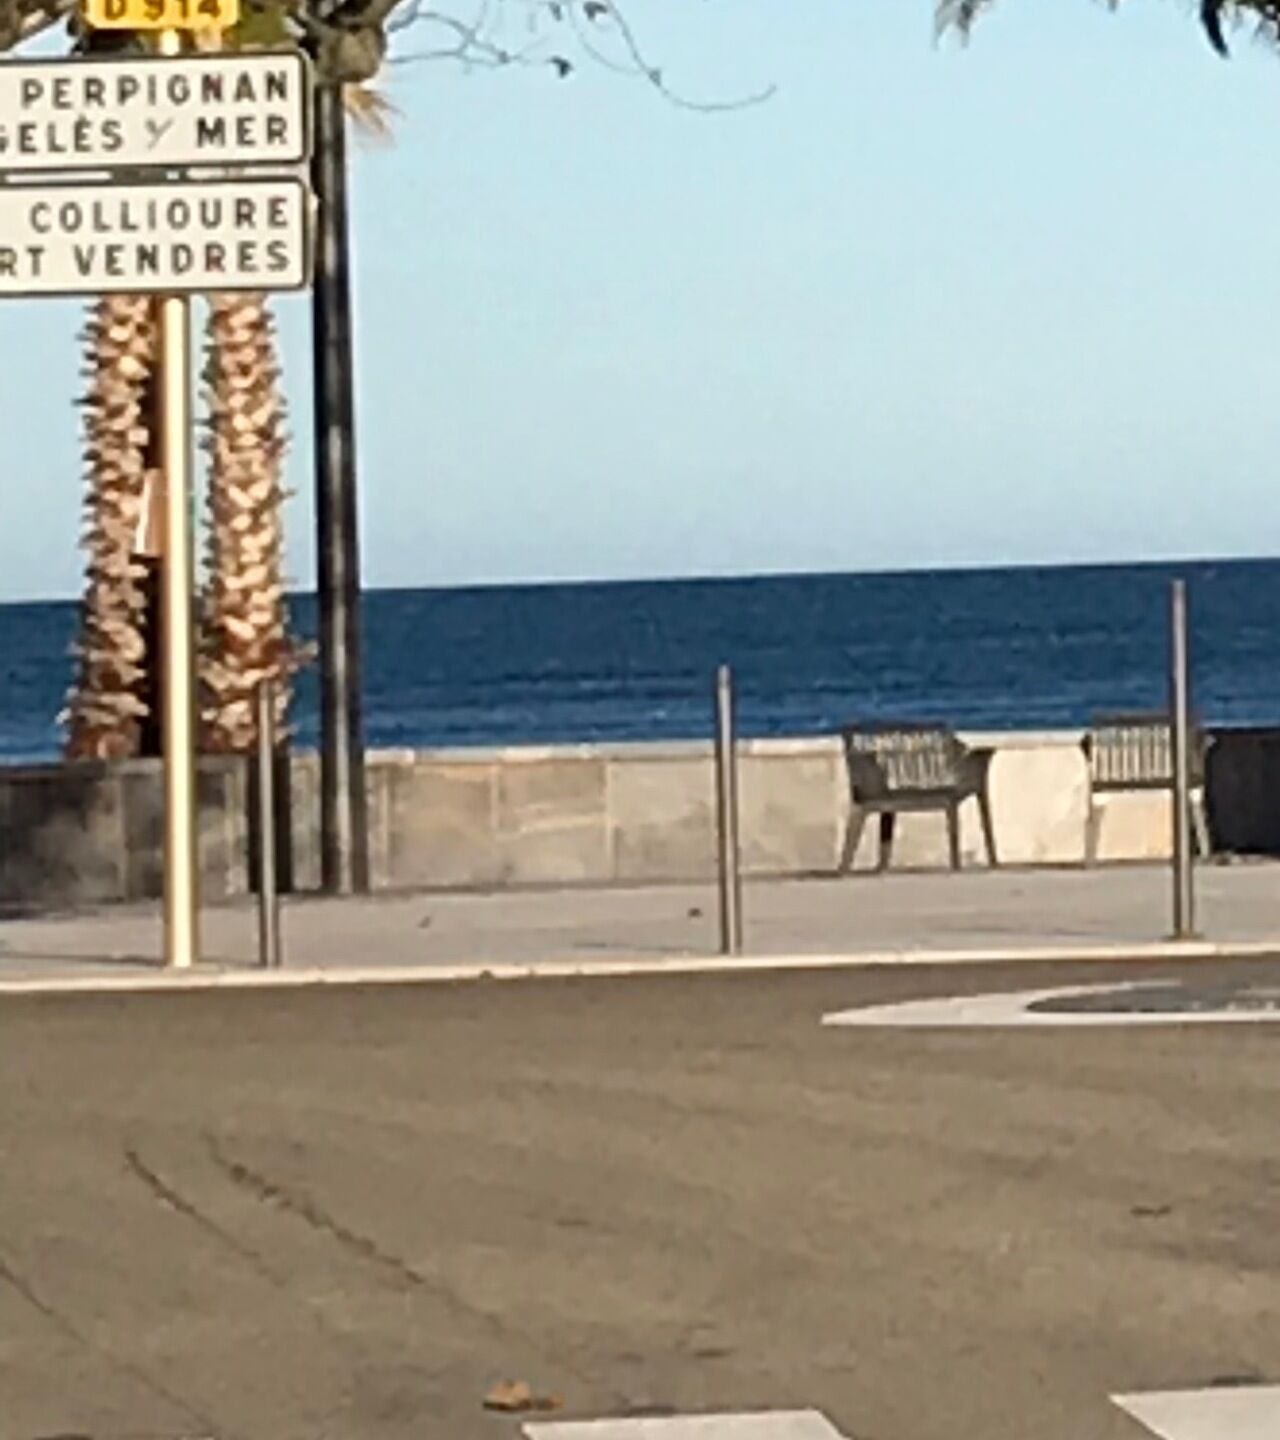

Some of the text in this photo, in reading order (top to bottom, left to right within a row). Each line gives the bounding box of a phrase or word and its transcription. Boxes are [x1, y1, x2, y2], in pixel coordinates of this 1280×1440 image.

[20, 70, 288, 110] PERPIGNAN
[196, 115, 288, 149] MER
[29, 197, 289, 234] COLLIOURE
[72, 240, 291, 276] VENDRES
